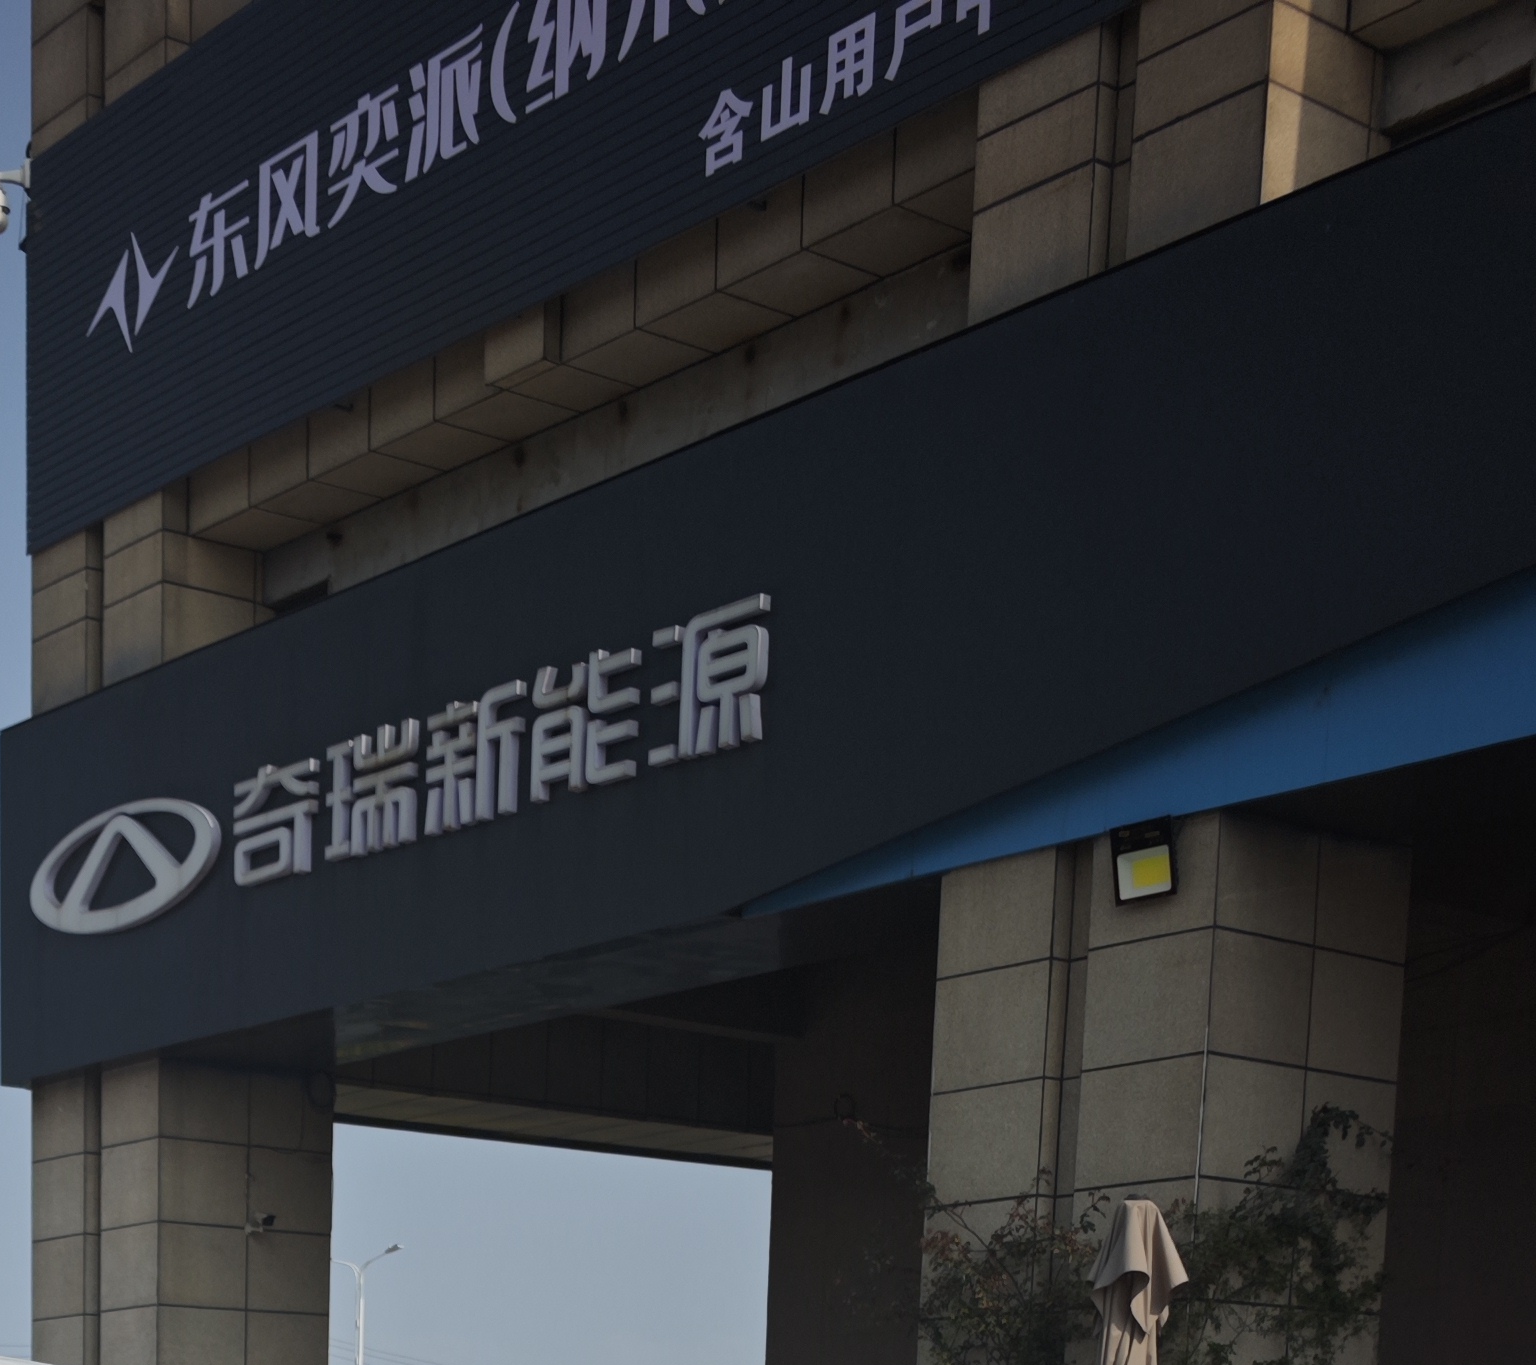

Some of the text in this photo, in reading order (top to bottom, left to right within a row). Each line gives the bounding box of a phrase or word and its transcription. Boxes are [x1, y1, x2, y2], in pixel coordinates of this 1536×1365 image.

[233, 592, 771, 887] 奇瑞新能源
